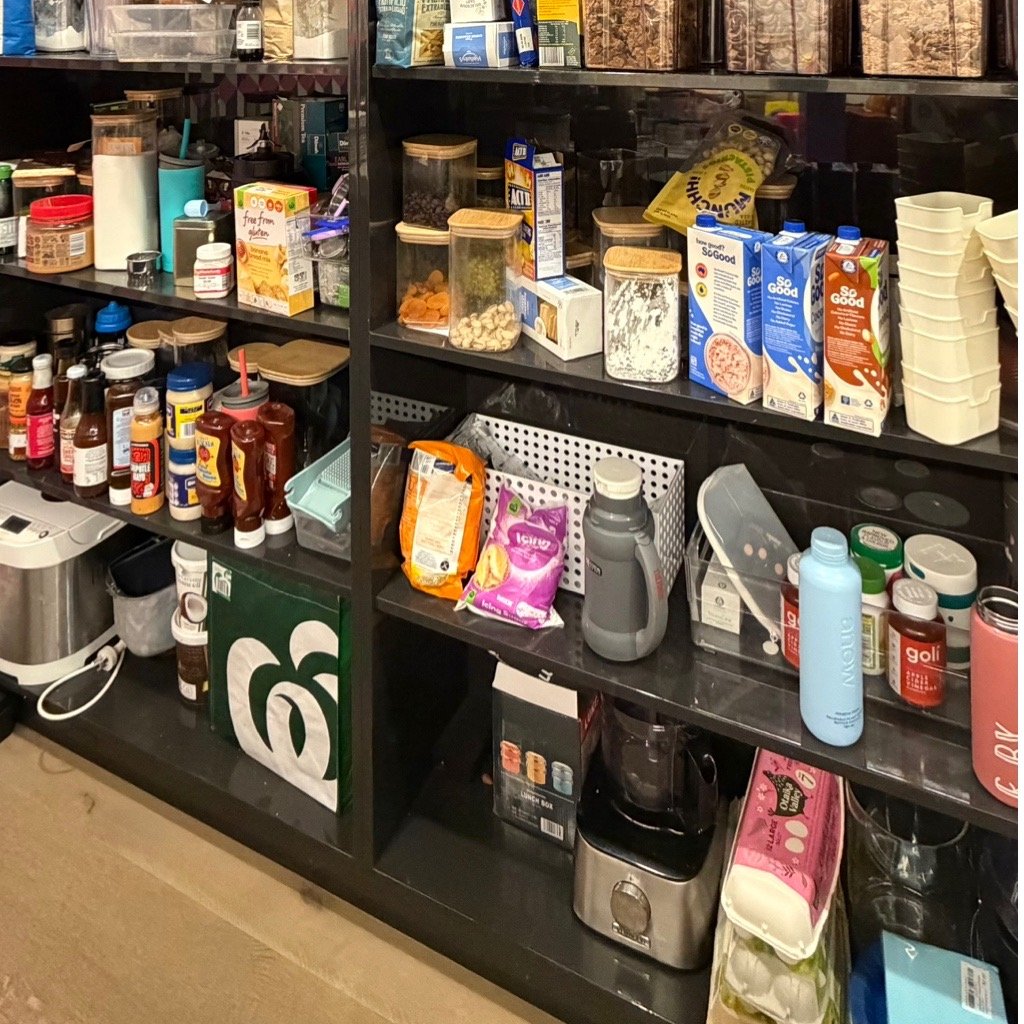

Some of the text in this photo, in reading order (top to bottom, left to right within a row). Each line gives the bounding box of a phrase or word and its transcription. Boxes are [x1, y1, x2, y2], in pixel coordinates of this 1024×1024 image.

[510, 188, 524, 206] ACT
[243, 210, 275, 229] free from
[248, 227, 270, 240] gluten
[767, 282, 799, 299] Good
[776, 275, 792, 288] So
[830, 292, 865, 309] Good
[840, 285, 858, 298] So
[516, 531, 551, 551] Icing
[905, 645, 940, 664] goli
[520, 791, 554, 810] LUNCH BOX
[780, 782, 793, 812] Otaika
[789, 787, 804, 814] Valley
[767, 819, 778, 844] LARGE
